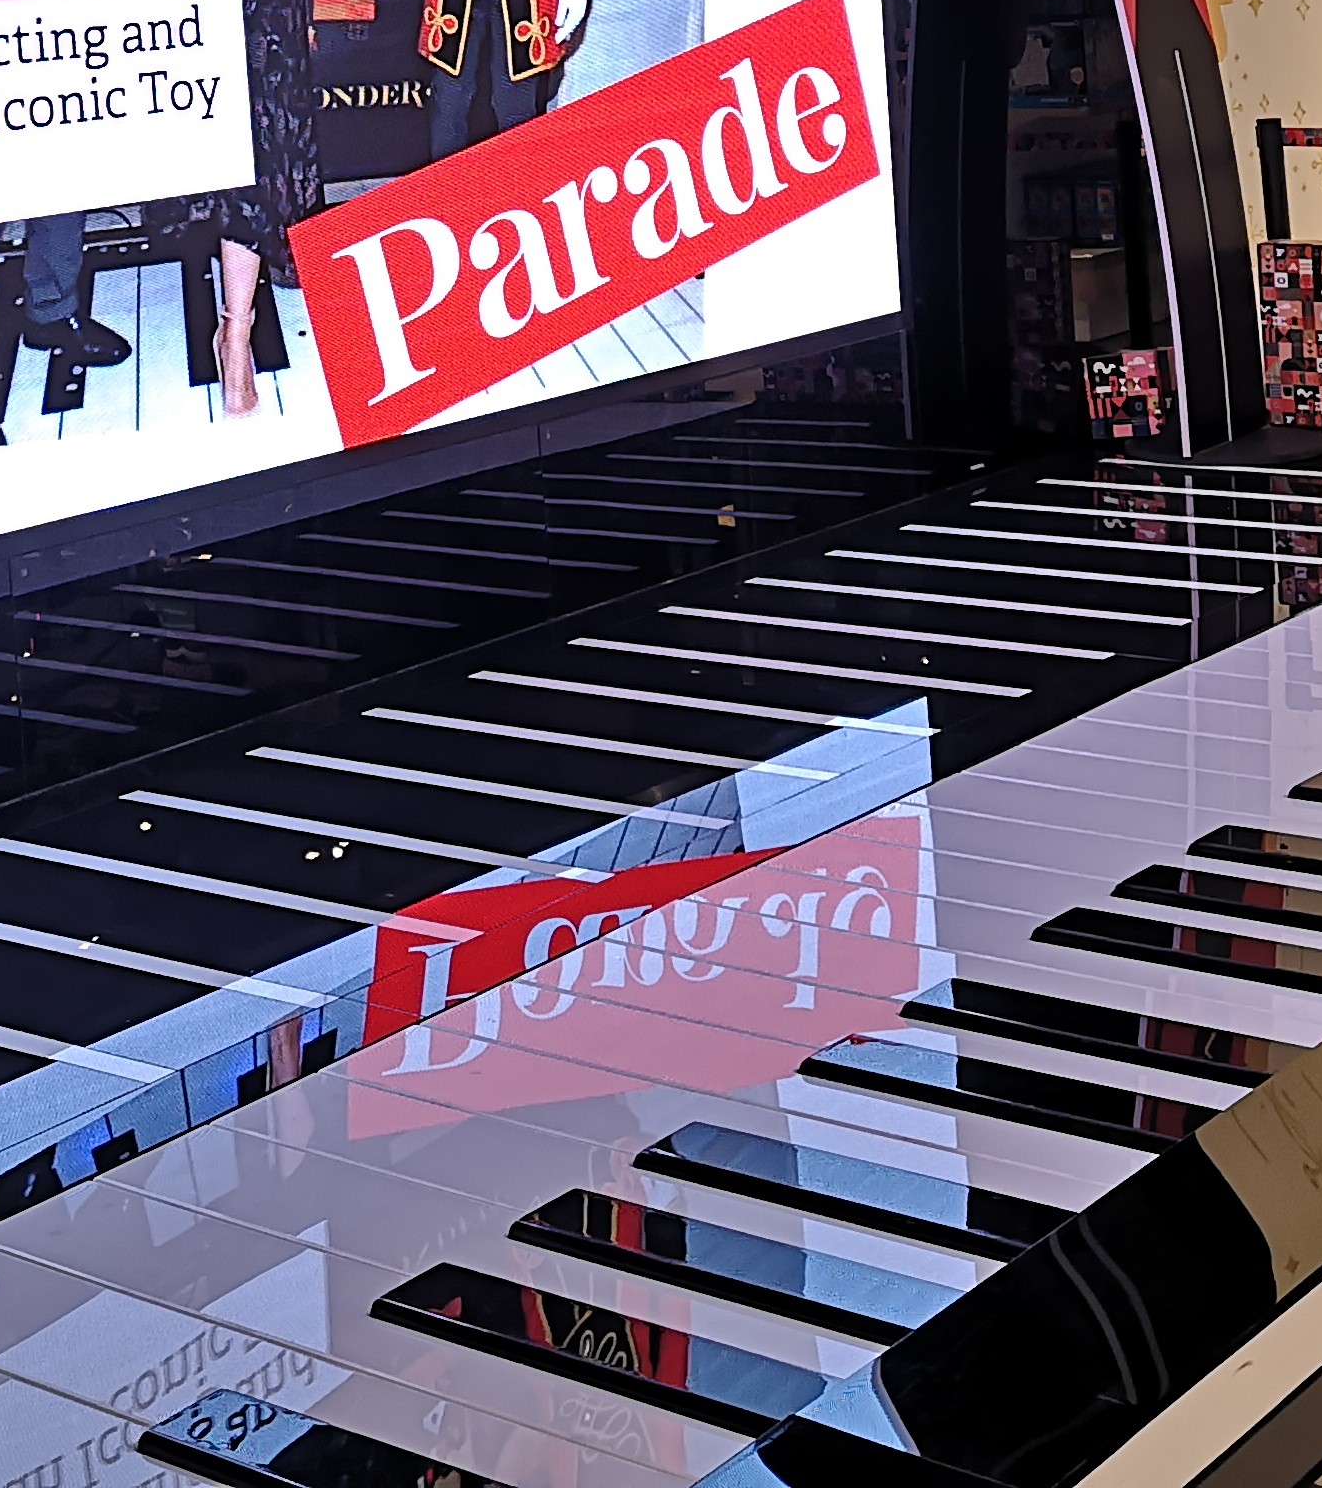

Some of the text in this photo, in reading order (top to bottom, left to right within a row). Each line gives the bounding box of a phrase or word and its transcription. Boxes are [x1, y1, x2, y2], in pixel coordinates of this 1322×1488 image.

[122, 3, 204, 54] and
[138, 69, 222, 121] Toy
[331, 57, 848, 408] Parade
